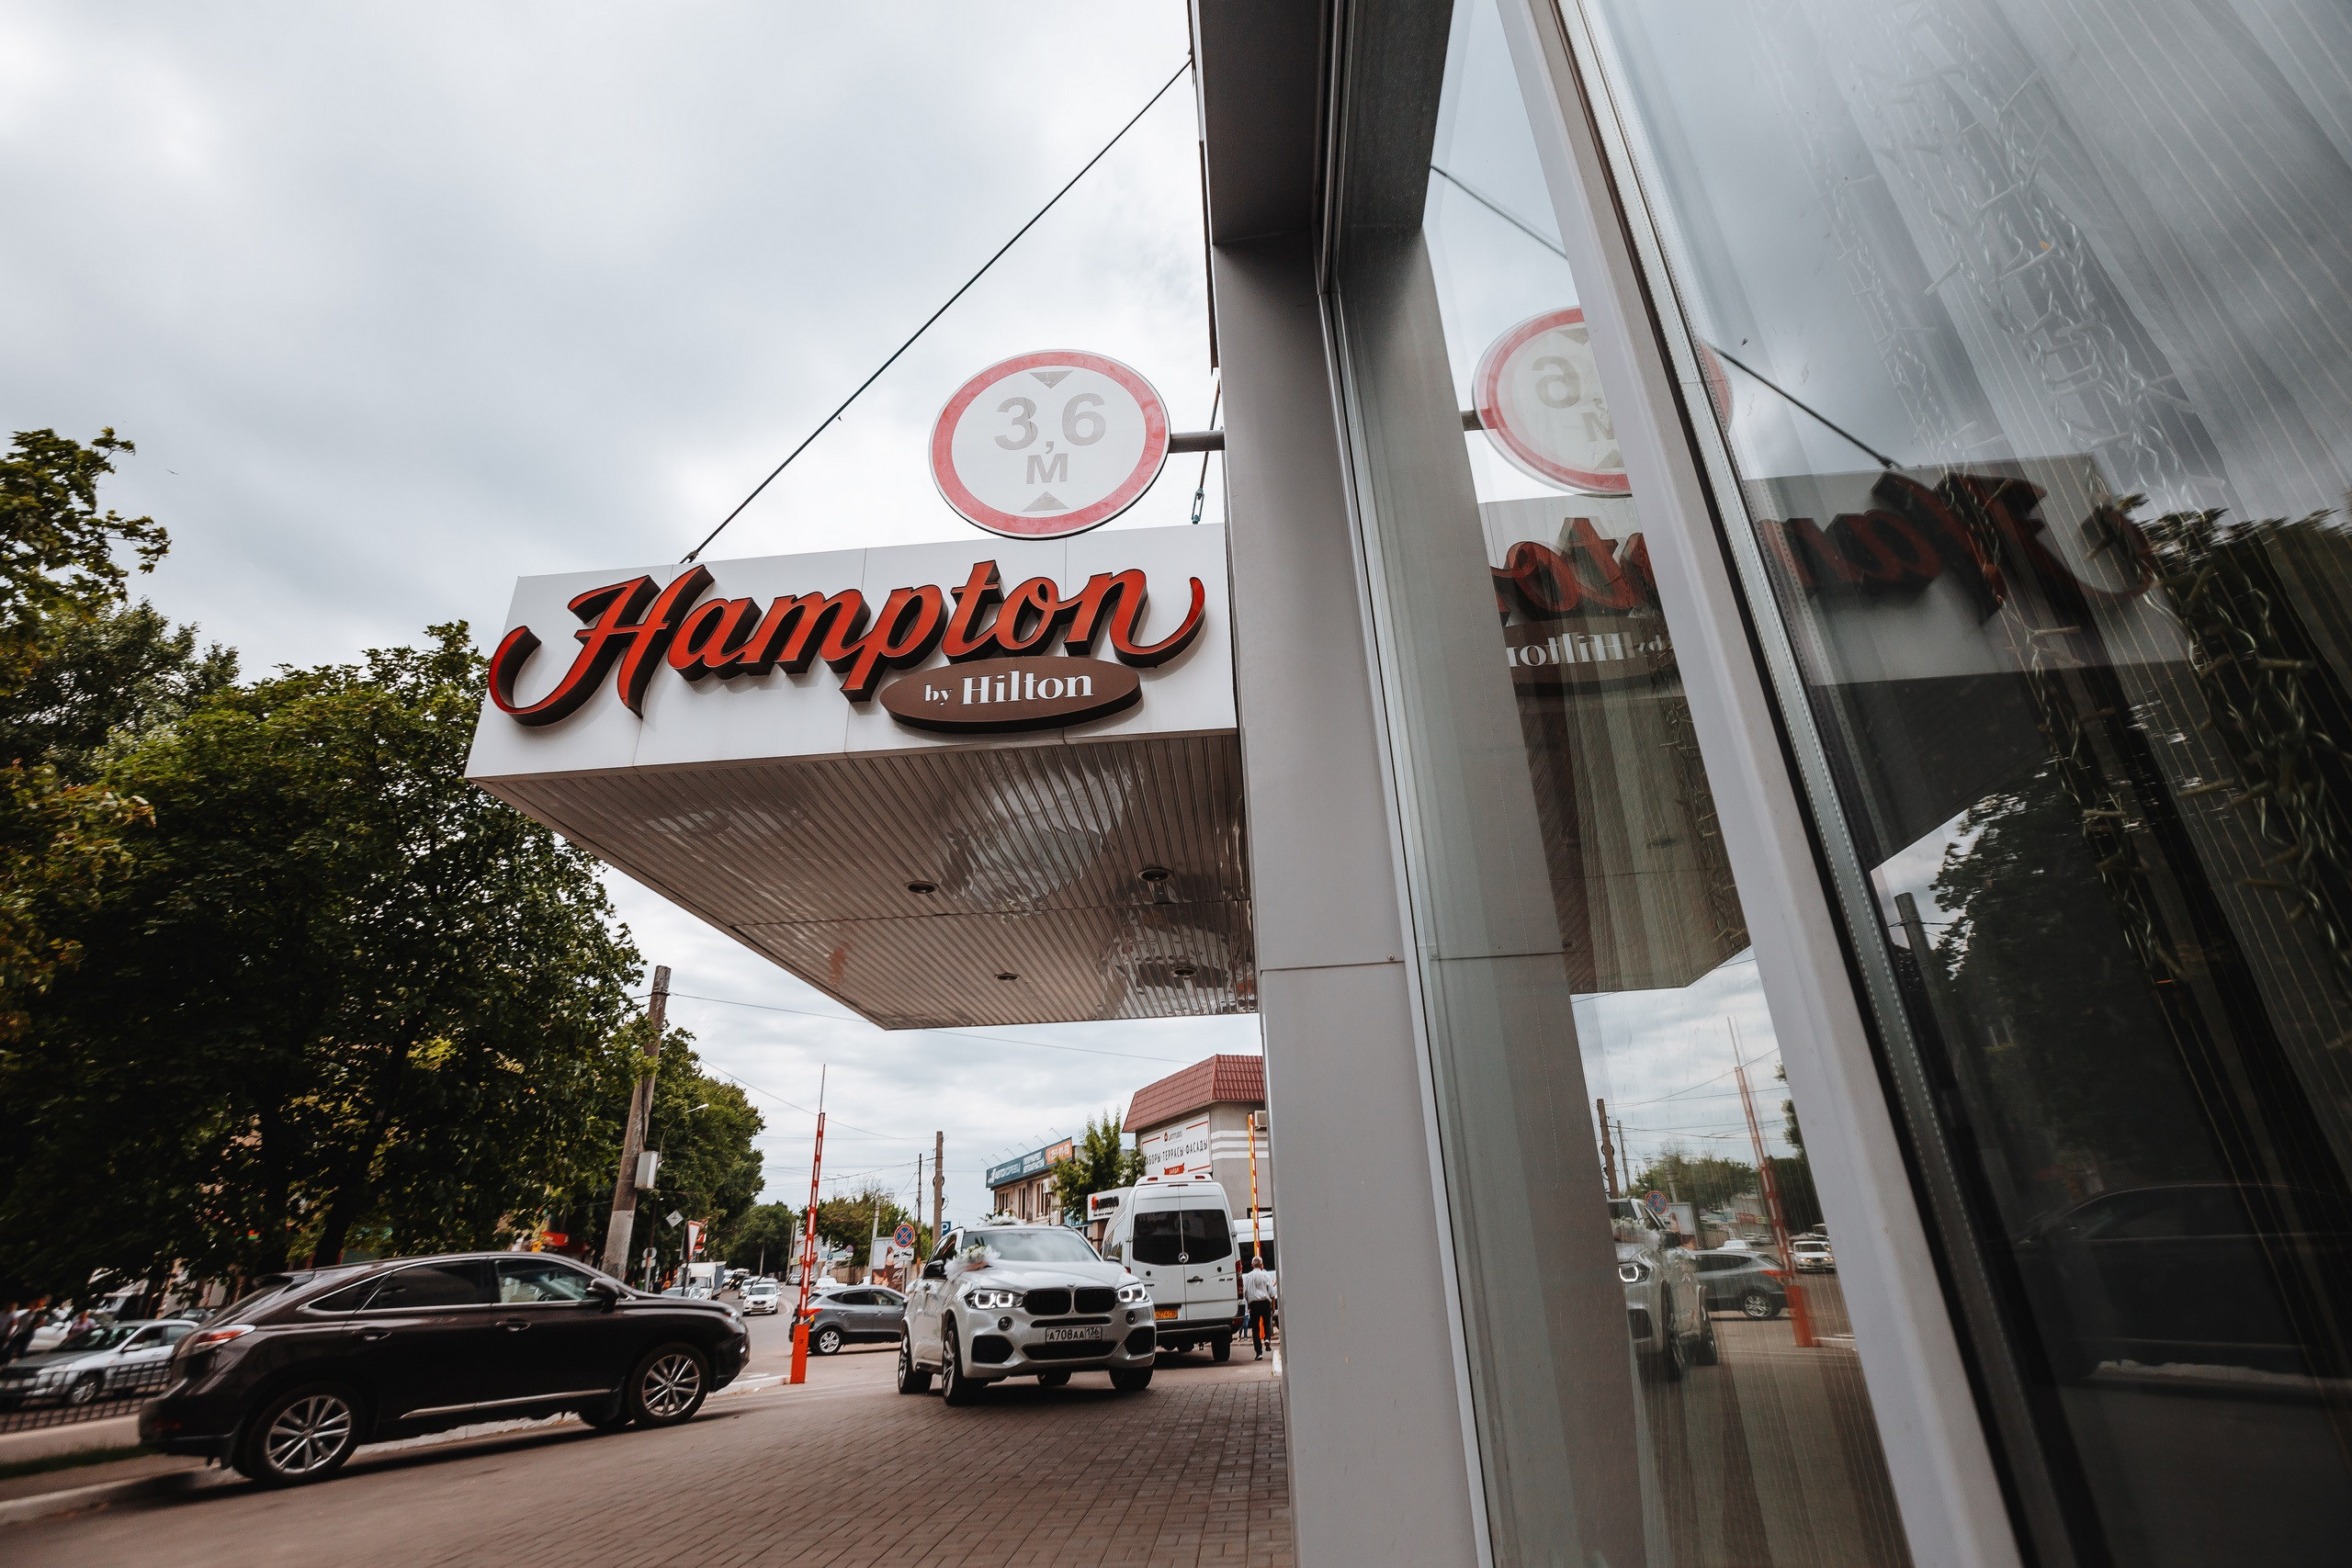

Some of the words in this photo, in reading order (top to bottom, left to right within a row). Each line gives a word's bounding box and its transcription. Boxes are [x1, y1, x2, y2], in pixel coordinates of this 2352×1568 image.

[994, 392, 1106, 454] 3,6
[489, 558, 1206, 727] Hampton
[924, 684, 953, 706] by
[960, 670, 1094, 705] Hilton
[1146, 1152, 1161, 1166] АБОРЫ
